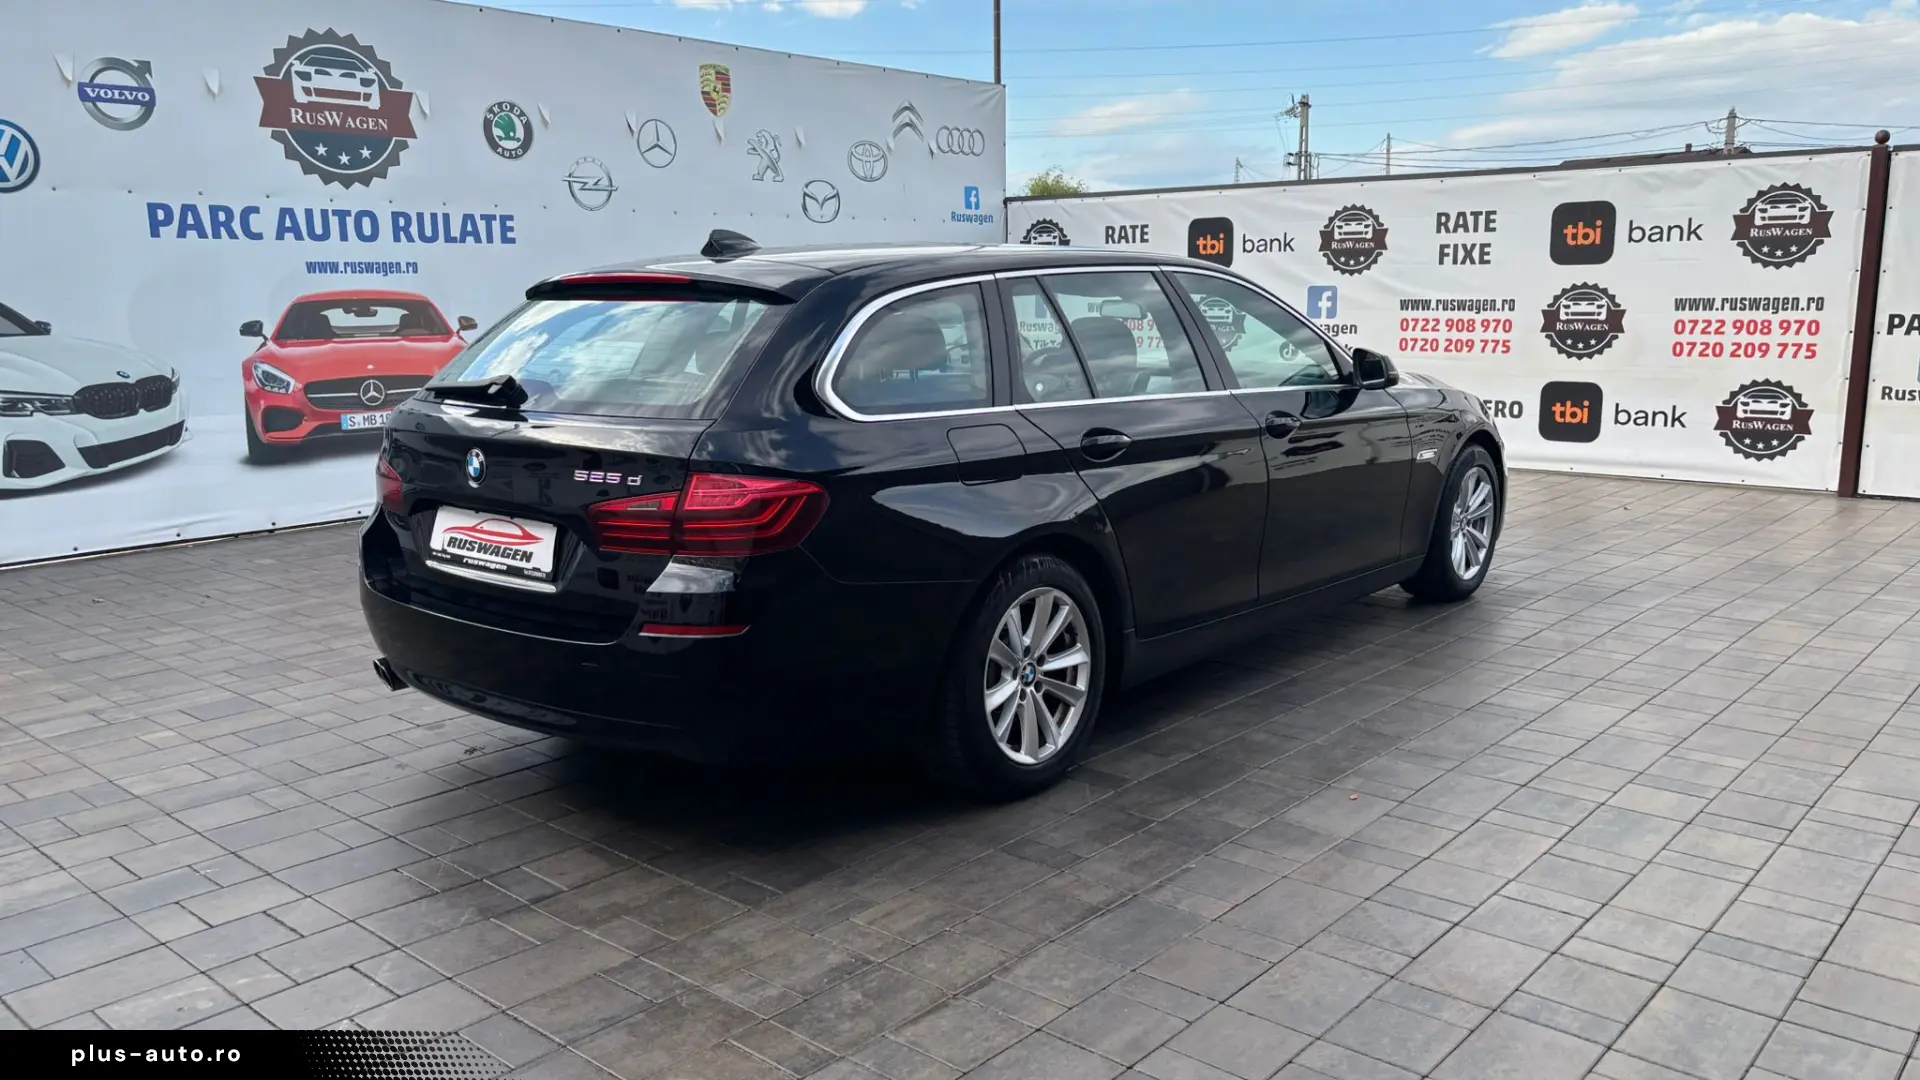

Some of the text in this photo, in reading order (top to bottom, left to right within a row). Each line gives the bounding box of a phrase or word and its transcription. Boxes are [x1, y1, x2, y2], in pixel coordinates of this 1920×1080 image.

[83, 86, 151, 102] VOLVO
[496, 146, 523, 157] AUTO
[146, 202, 517, 245] PARC AUTO RULATE
[950, 210, 994, 226] Ruswagen
[1435, 210, 1497, 234] RATE
[1104, 224, 1150, 245] RATE
[1563, 217, 1704, 246] tbi bank
[1196, 231, 1295, 255] tbi bank
[1438, 243, 1492, 266] FIXE
[305, 260, 419, 277] www.ruswagen.ro
[1399, 298, 1516, 314] www.ruswagen.ro
[1674, 296, 1825, 315] www.ruswagen.ro
[1399, 317, 1513, 334] 0722 908 970
[1673, 318, 1821, 336] 0722 908 970
[1399, 337, 1512, 354] 0720 209 775
[1671, 341, 1818, 360] 0720 209 775
[348, 415, 356, 428] S
[362, 415, 378, 426] MB
[1551, 400, 1688, 429] tbi bank
[573, 469, 643, 486] 525 d
[446, 535, 535, 564] RUSWAGEN
[462, 556, 508, 571] ruswagen
